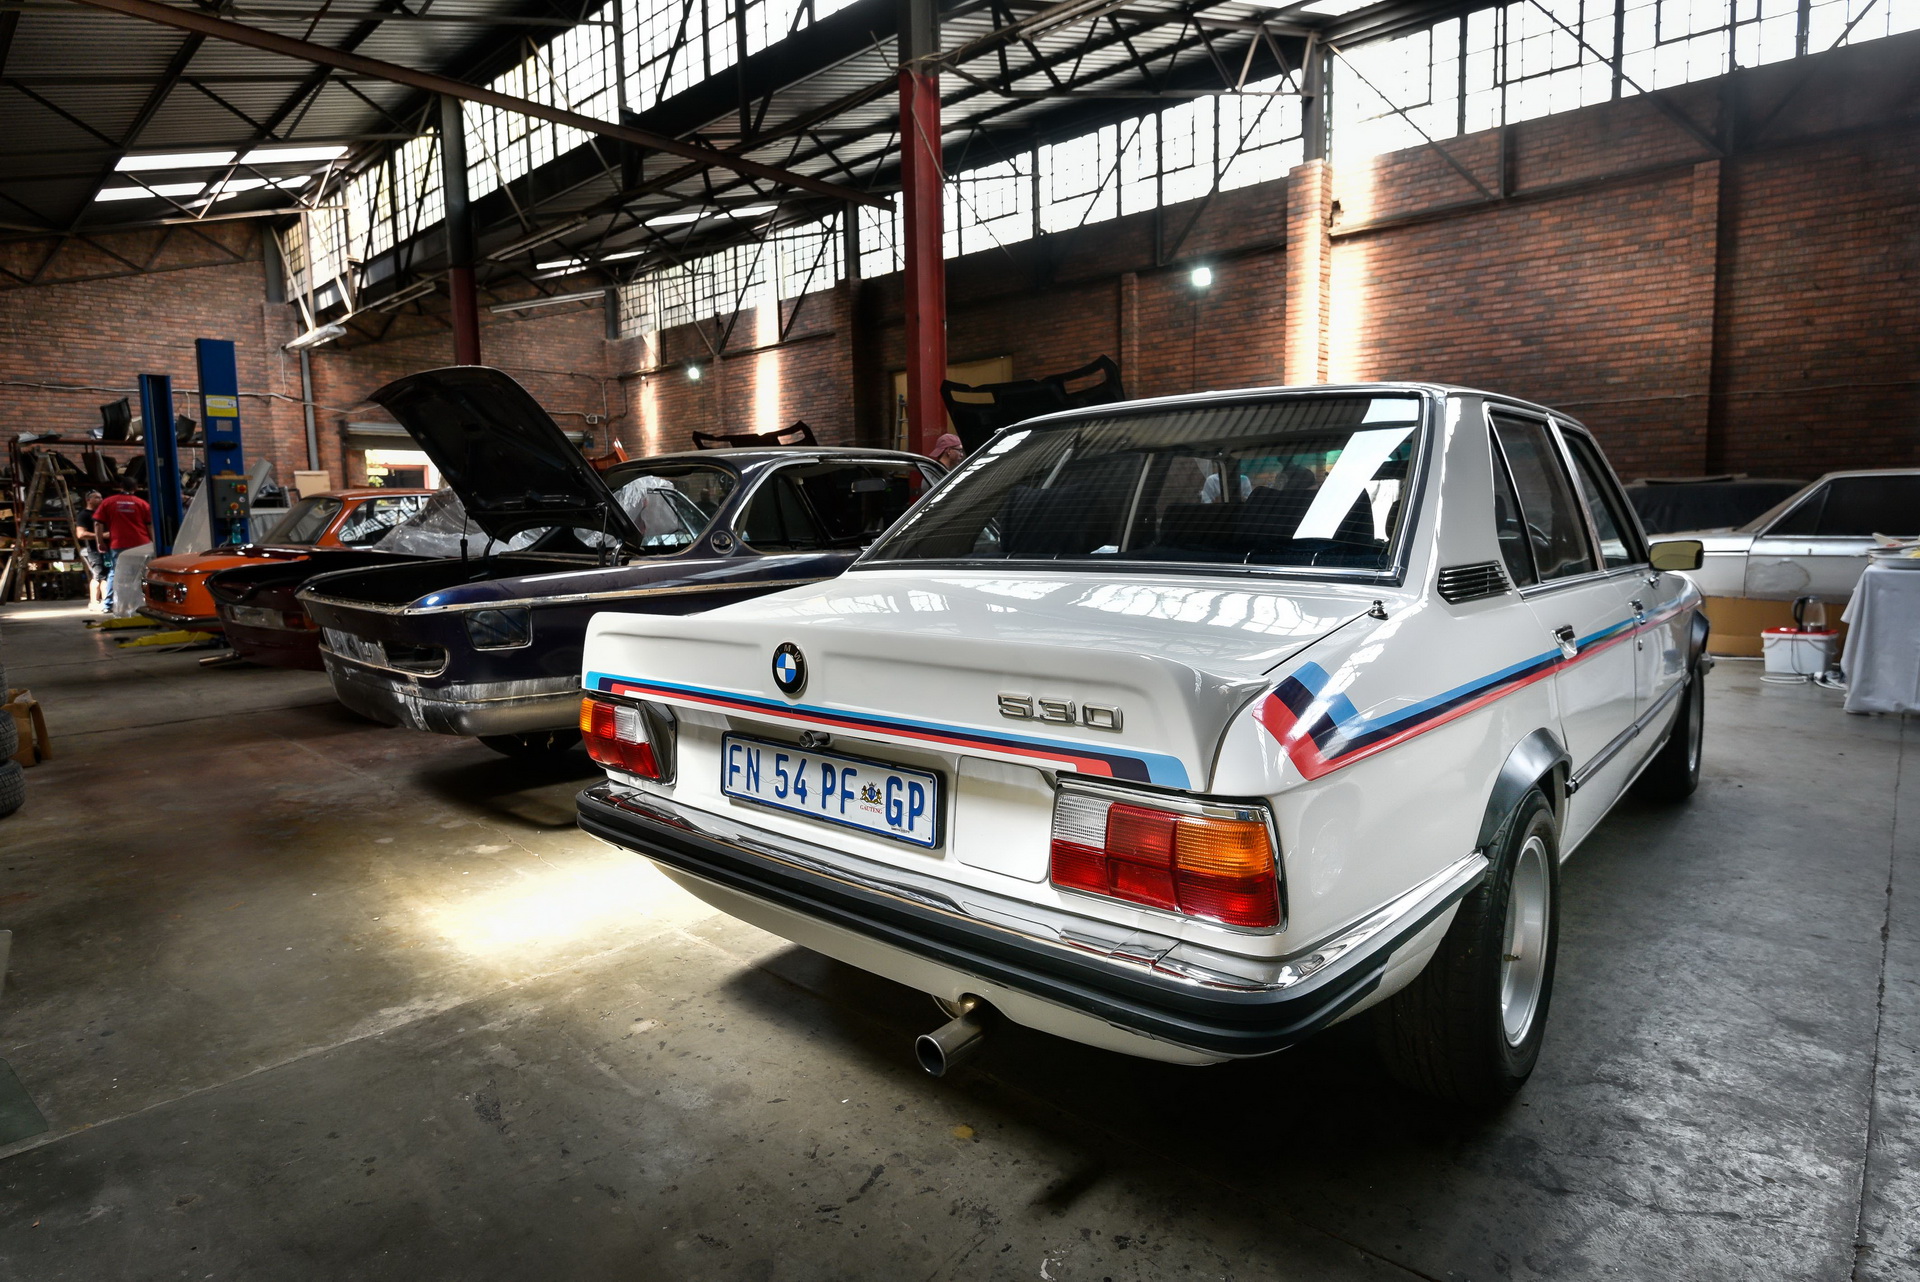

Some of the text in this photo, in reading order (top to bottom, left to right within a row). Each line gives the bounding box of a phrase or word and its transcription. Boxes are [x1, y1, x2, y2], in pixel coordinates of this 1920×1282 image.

[998, 691, 1124, 733] 530
[728, 744, 925, 831] FN 54 PF GP
[859, 804, 883, 815] GAUTENG
